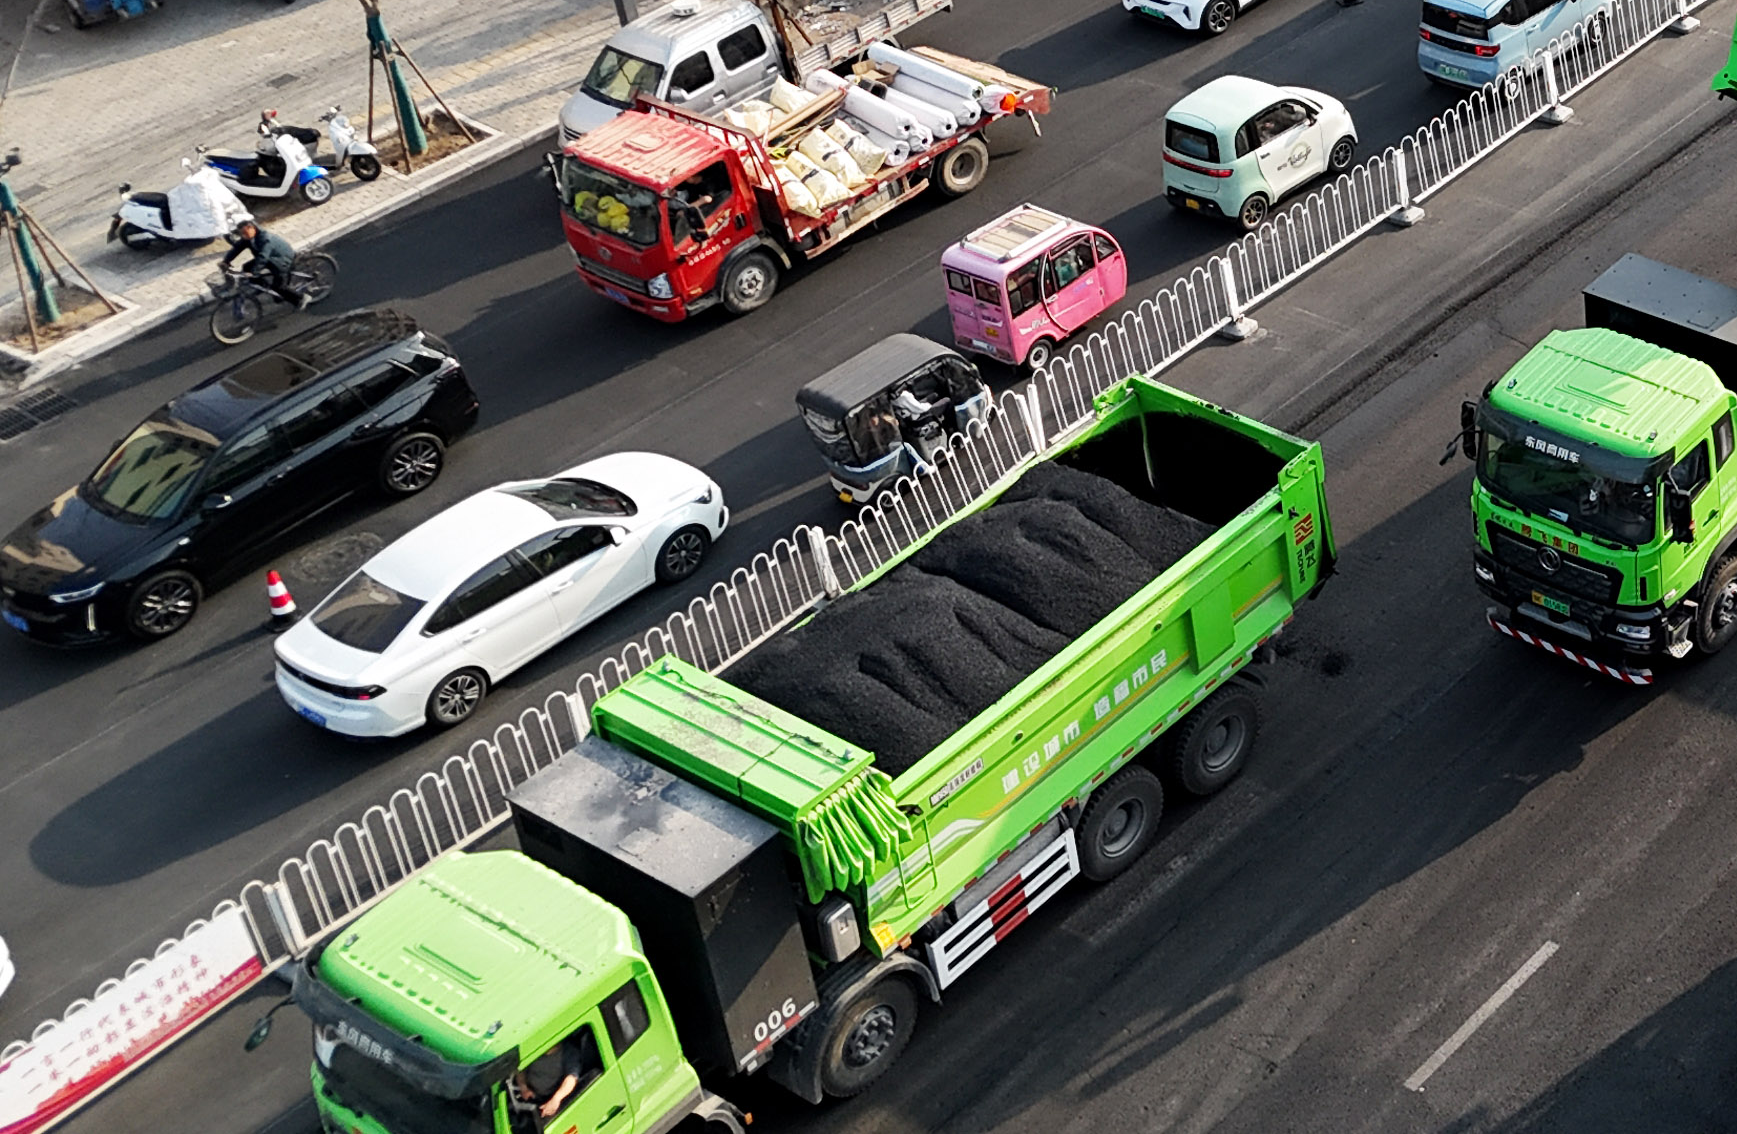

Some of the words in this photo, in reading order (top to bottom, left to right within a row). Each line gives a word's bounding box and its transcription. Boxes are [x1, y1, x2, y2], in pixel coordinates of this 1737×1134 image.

[1524, 435, 1581, 465] 东风商用车
[1001, 719, 1081, 795] 建设城市
[753, 997, 798, 1042] 006
